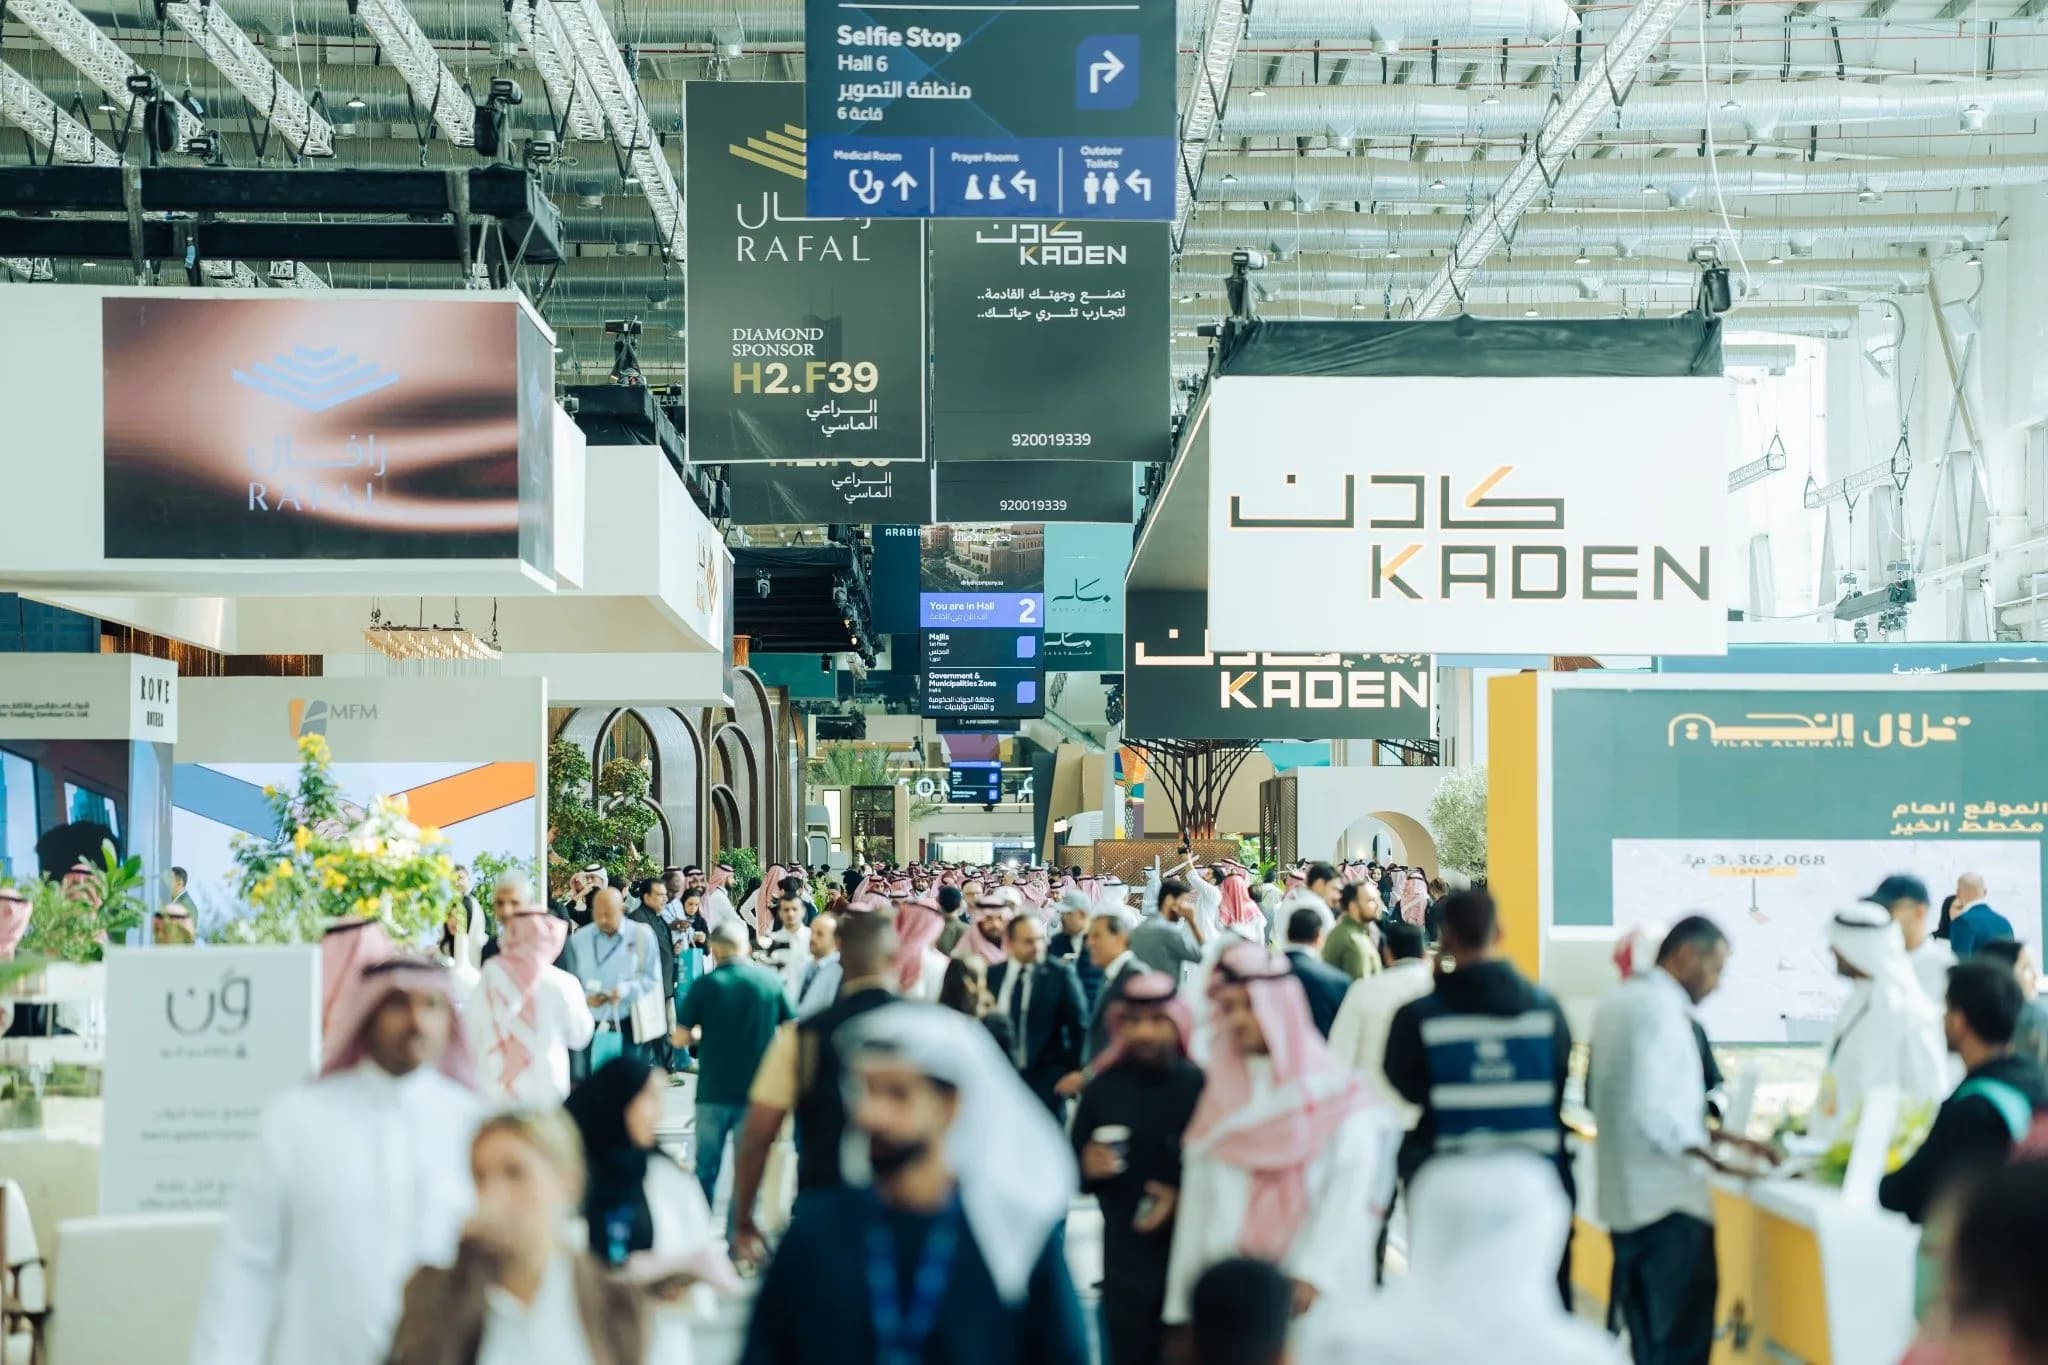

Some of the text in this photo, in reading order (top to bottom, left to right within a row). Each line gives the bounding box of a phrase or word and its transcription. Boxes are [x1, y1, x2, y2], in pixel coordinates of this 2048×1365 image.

[837, 25, 962, 53] Selfie Stop
[837, 54, 889, 73] Hall 6
[837, 81, 972, 102] منطقة التصوير
[837, 106, 883, 121] قاعة 6
[833, 150, 902, 161] Medical Room
[951, 152, 1020, 165] Prayer Rooms
[1080, 145, 1123, 157] Outdoor
[1084, 158, 1119, 169] Toilets
[975, 221, 1083, 244] كادن
[736, 235, 872, 263] RAFAL
[1019, 245, 1128, 265] KADEN
[1082, 306, 1126, 321] لتجارب
[732, 328, 824, 342] DIAMOND
[732, 343, 816, 357] SPONSOR
[732, 361, 880, 395] H2.F39
[806, 399, 878, 421] الراعي
[821, 416, 878, 438] الماسي
[1011, 433, 1092, 447] 920019339
[831, 471, 892, 490] الراعي
[844, 486, 892, 504] الماسي
[1230, 465, 1566, 530] كادن
[999, 499, 1068, 512] 920019339
[1371, 544, 1710, 601] KADEN
[929, 601, 947, 610] You
[966, 601, 975, 610] in
[976, 601, 995, 610] Hall
[1018, 598, 1037, 623] 2
[928, 633, 950, 642] Majlis
[928, 671, 981, 680] Government &
[928, 680, 997, 689] Municipalities Zone
[141, 675, 170, 705] ROVE
[1220, 670, 1428, 708] KADEN
[330, 703, 378, 720] MFM
[1892, 801, 1956, 819] العام
